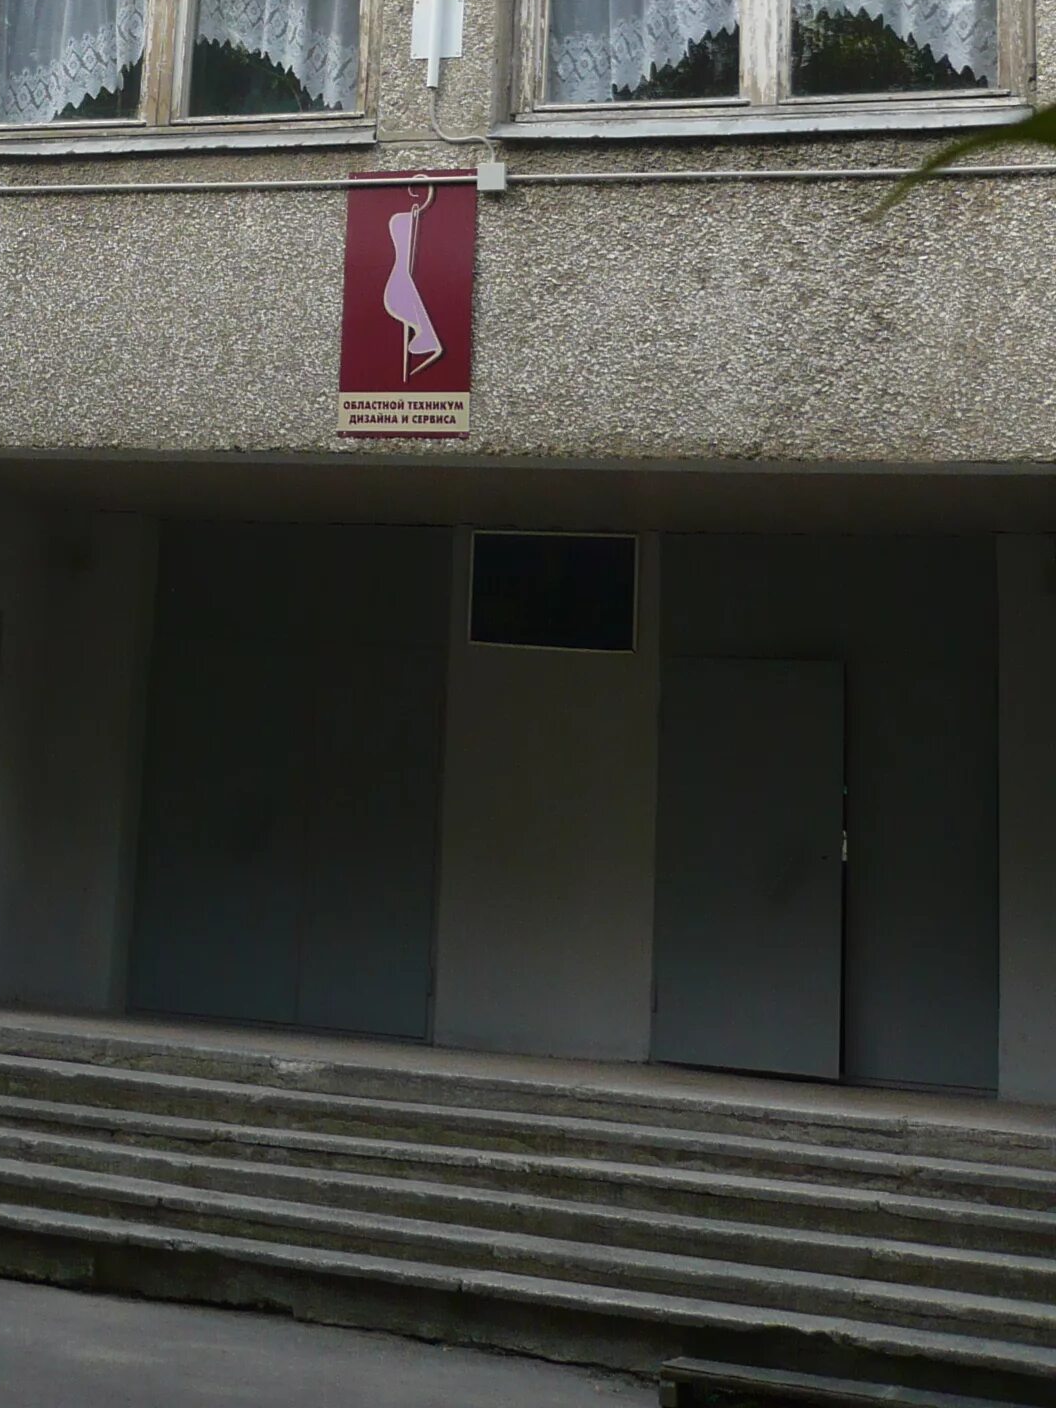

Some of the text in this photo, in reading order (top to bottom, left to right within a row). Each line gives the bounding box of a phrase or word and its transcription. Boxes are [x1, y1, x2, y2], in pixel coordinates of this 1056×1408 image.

[343, 399, 464, 410] ОБЛАСТНОЙ ТЕХНИКУМ
[349, 413, 456, 425] ДИЗАЙНА И СЕРВИСА
